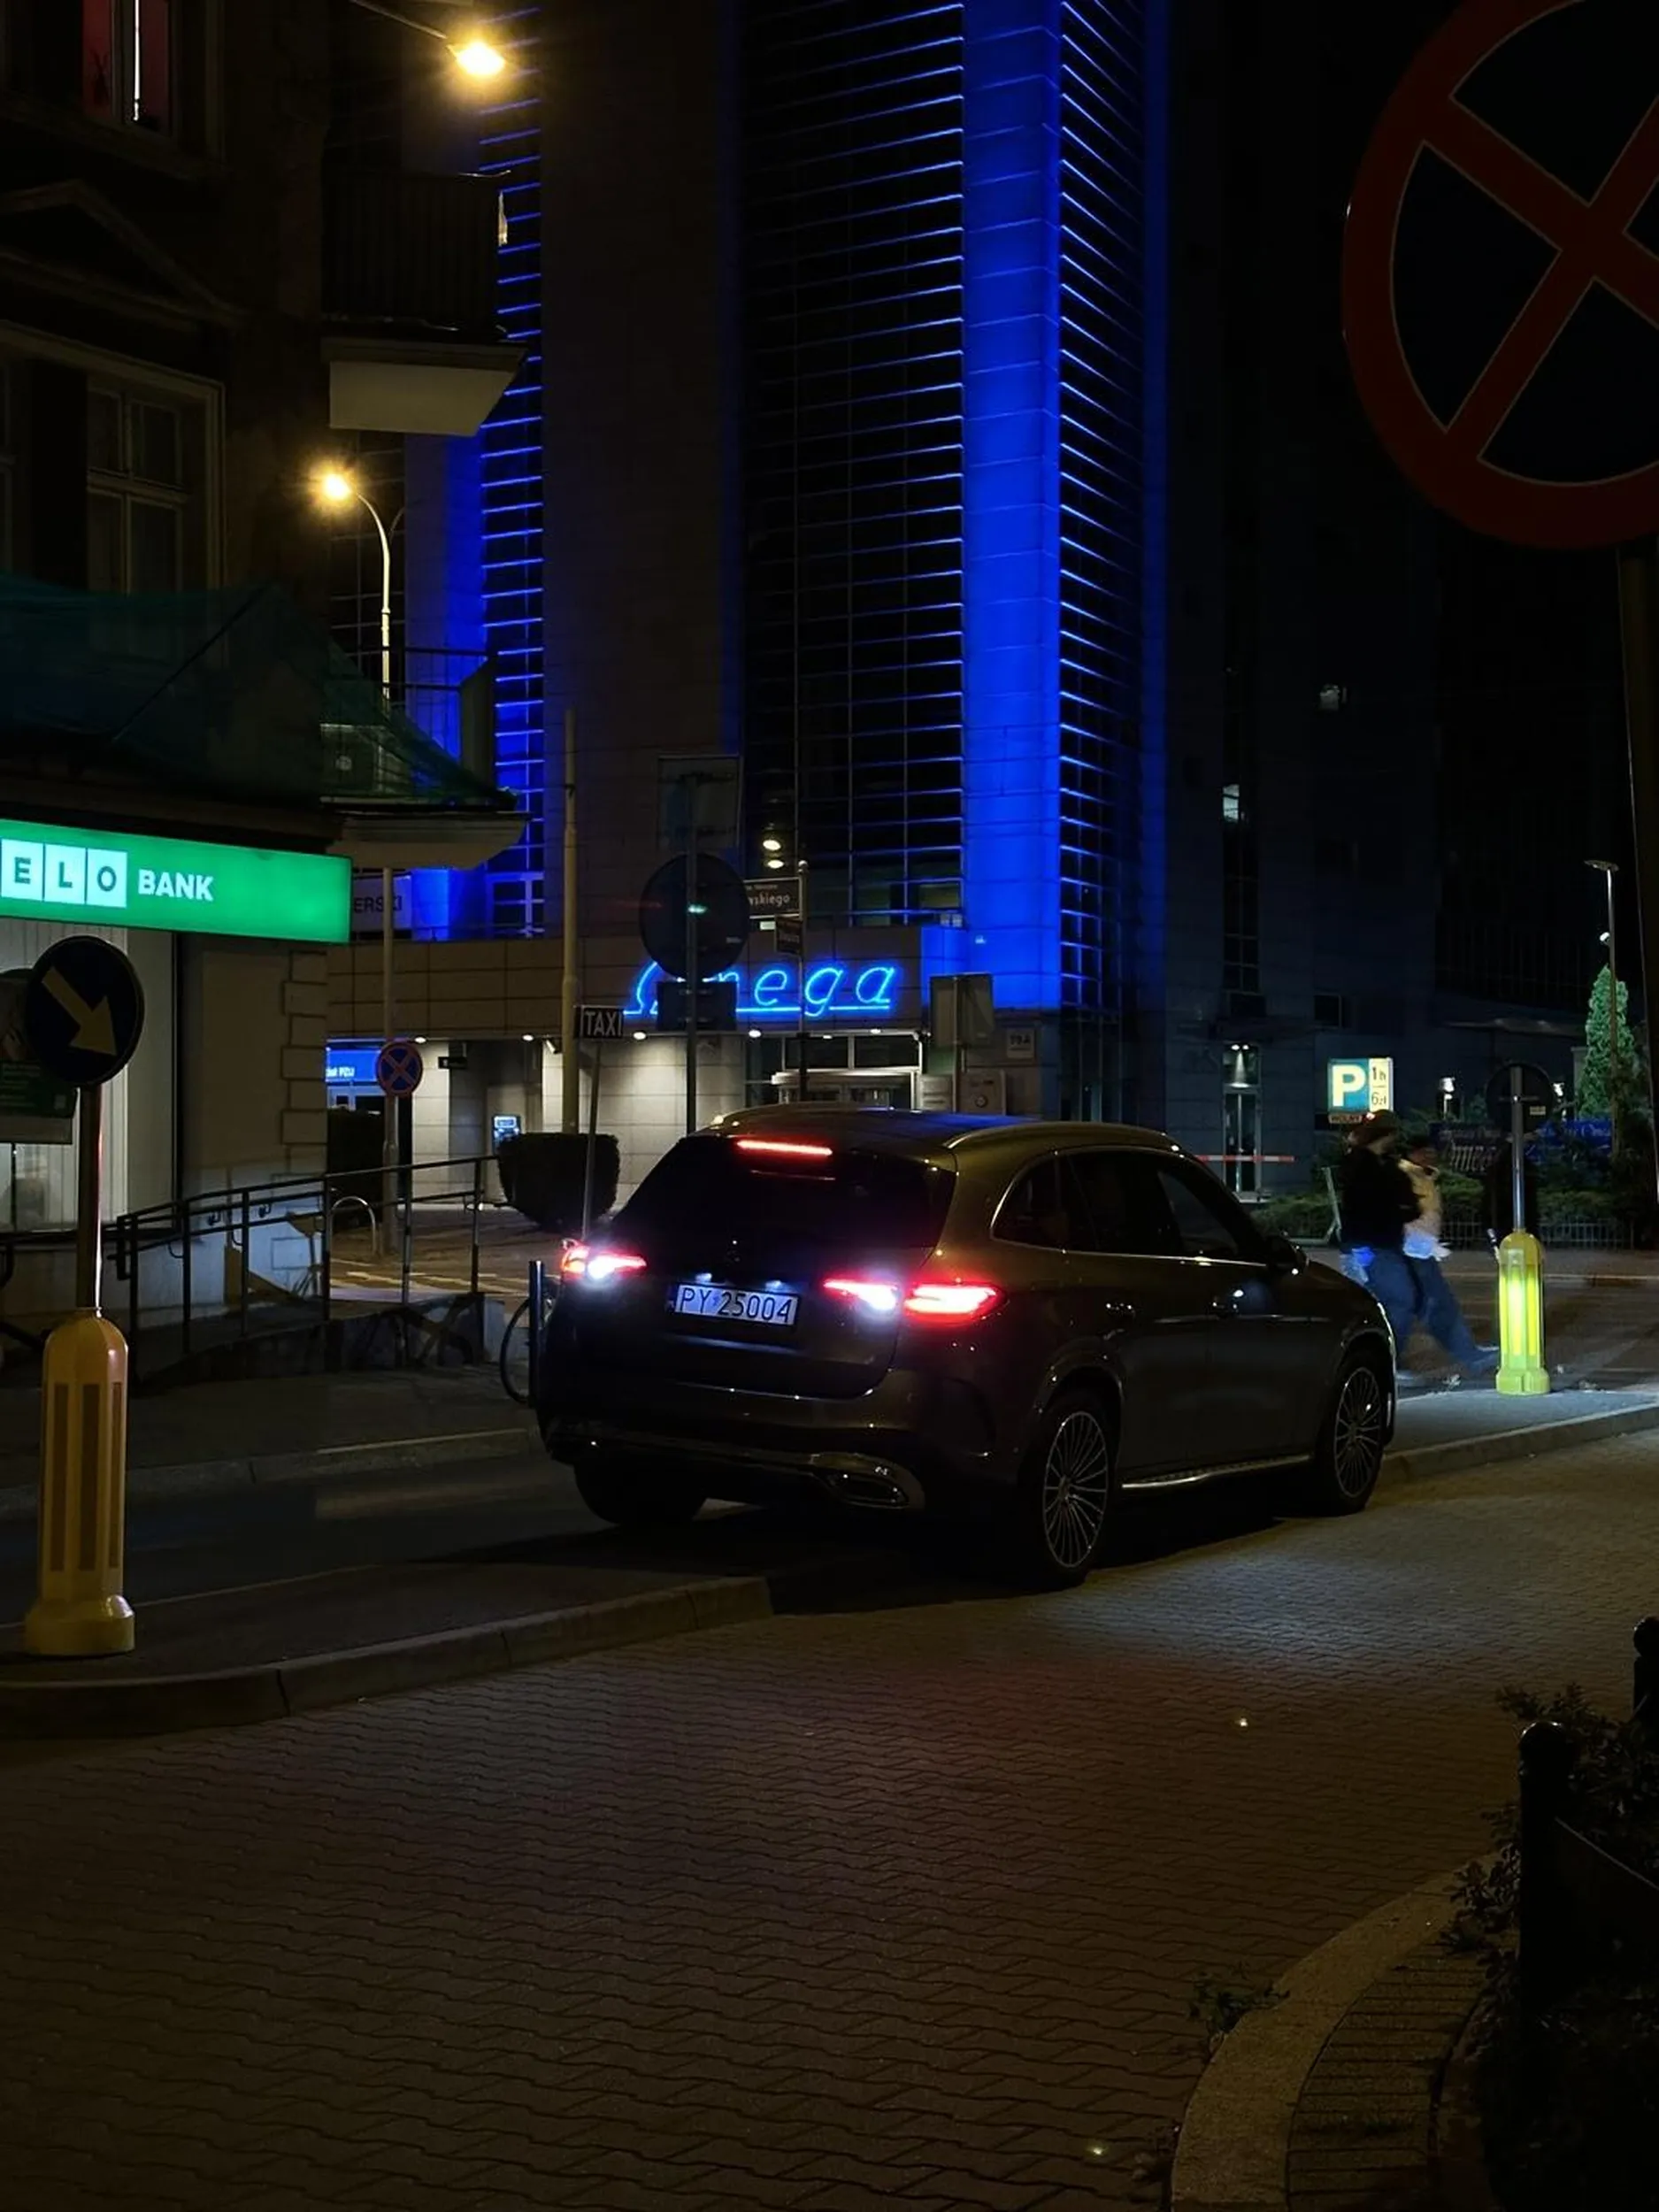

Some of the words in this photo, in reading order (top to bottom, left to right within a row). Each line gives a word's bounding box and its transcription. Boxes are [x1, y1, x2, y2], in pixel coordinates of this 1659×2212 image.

[138, 868, 214, 902] BANK
[585, 1010, 622, 1037] TAXI
[1333, 1064, 1366, 1107] P
[680, 1287, 712, 1314] PY
[718, 1291, 792, 1323] 25004
